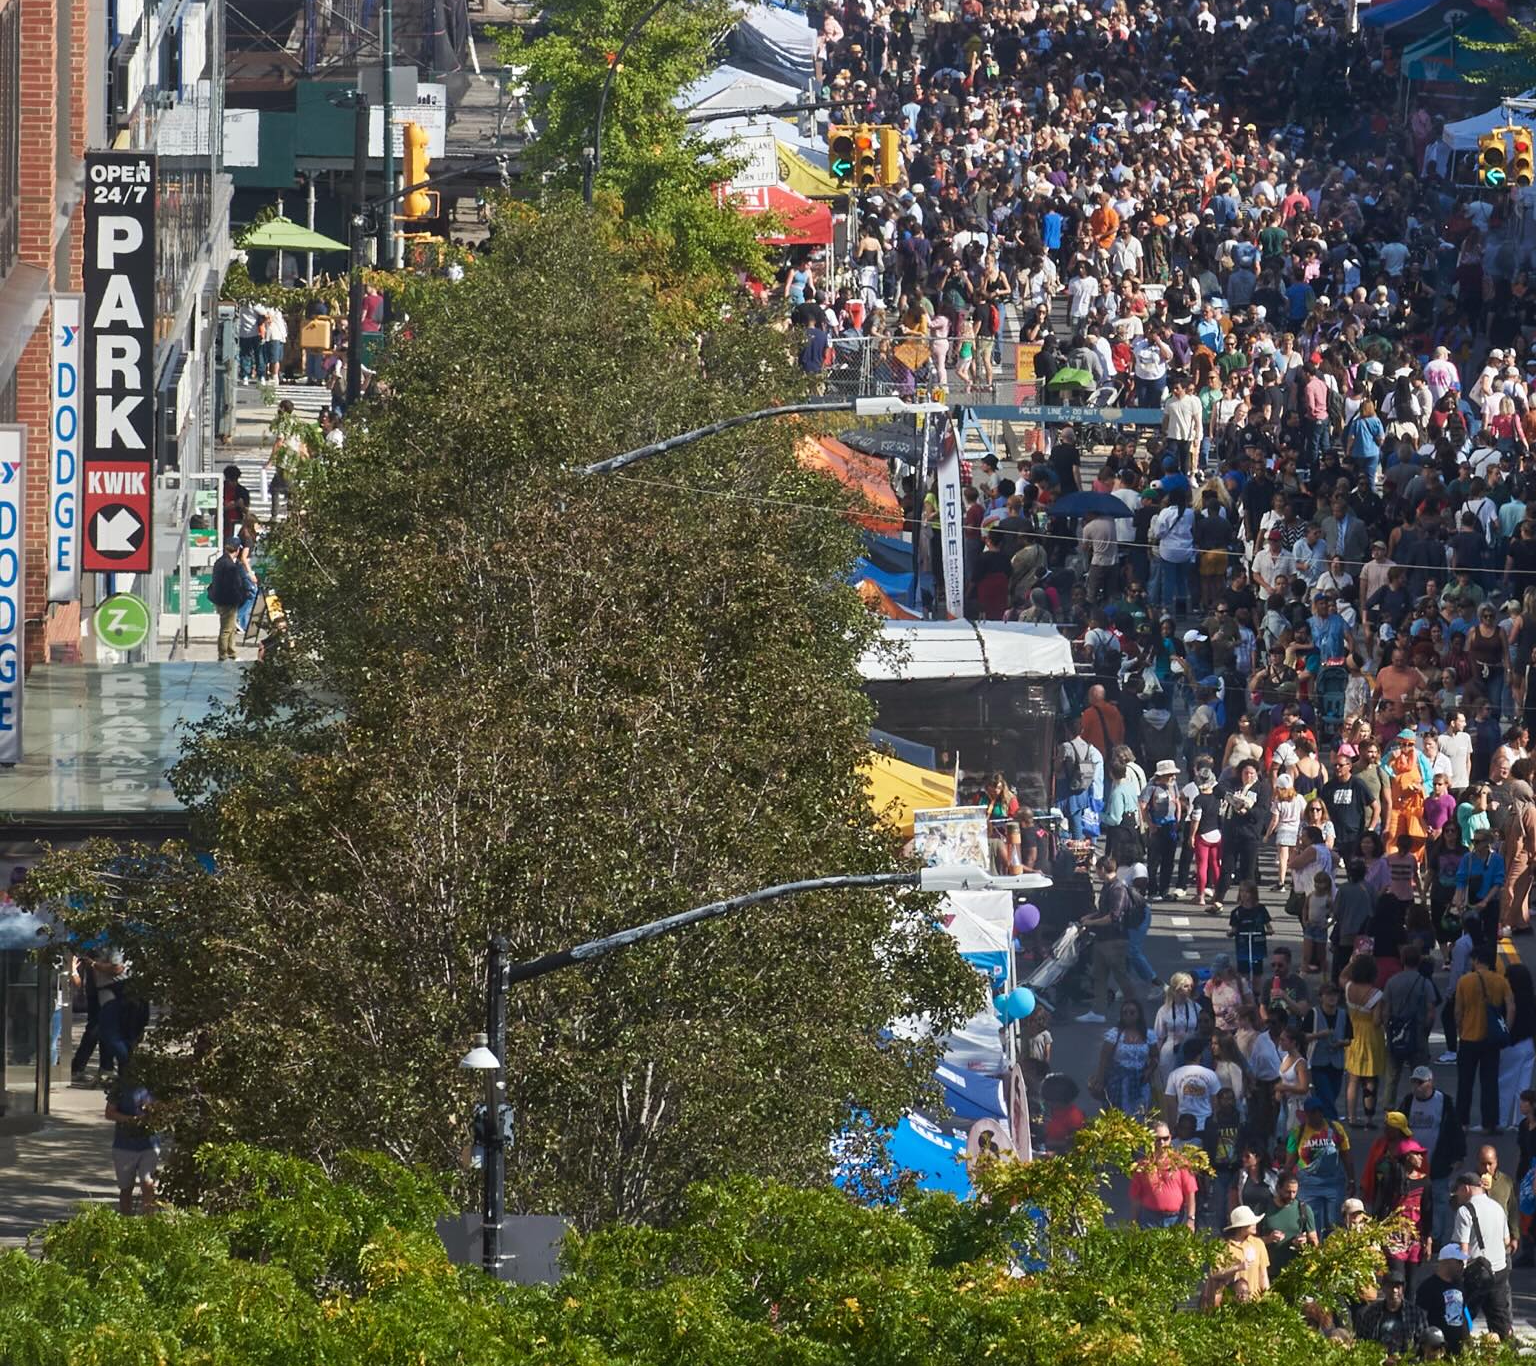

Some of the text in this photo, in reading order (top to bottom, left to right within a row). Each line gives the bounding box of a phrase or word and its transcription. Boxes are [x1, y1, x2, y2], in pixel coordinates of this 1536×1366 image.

[90, 165, 150, 184] OPEN
[94, 186, 147, 205] 24/7
[93, 215, 146, 449] PARK
[1018, 407, 1042, 416] POLICE
[1047, 408, 1062, 416] LINE
[55, 362, 77, 572] DODGE
[88, 471, 146, 495] KWIK
[945, 483, 958, 556] FREE
[1303, 1138, 1336, 1149] JAMAICA
